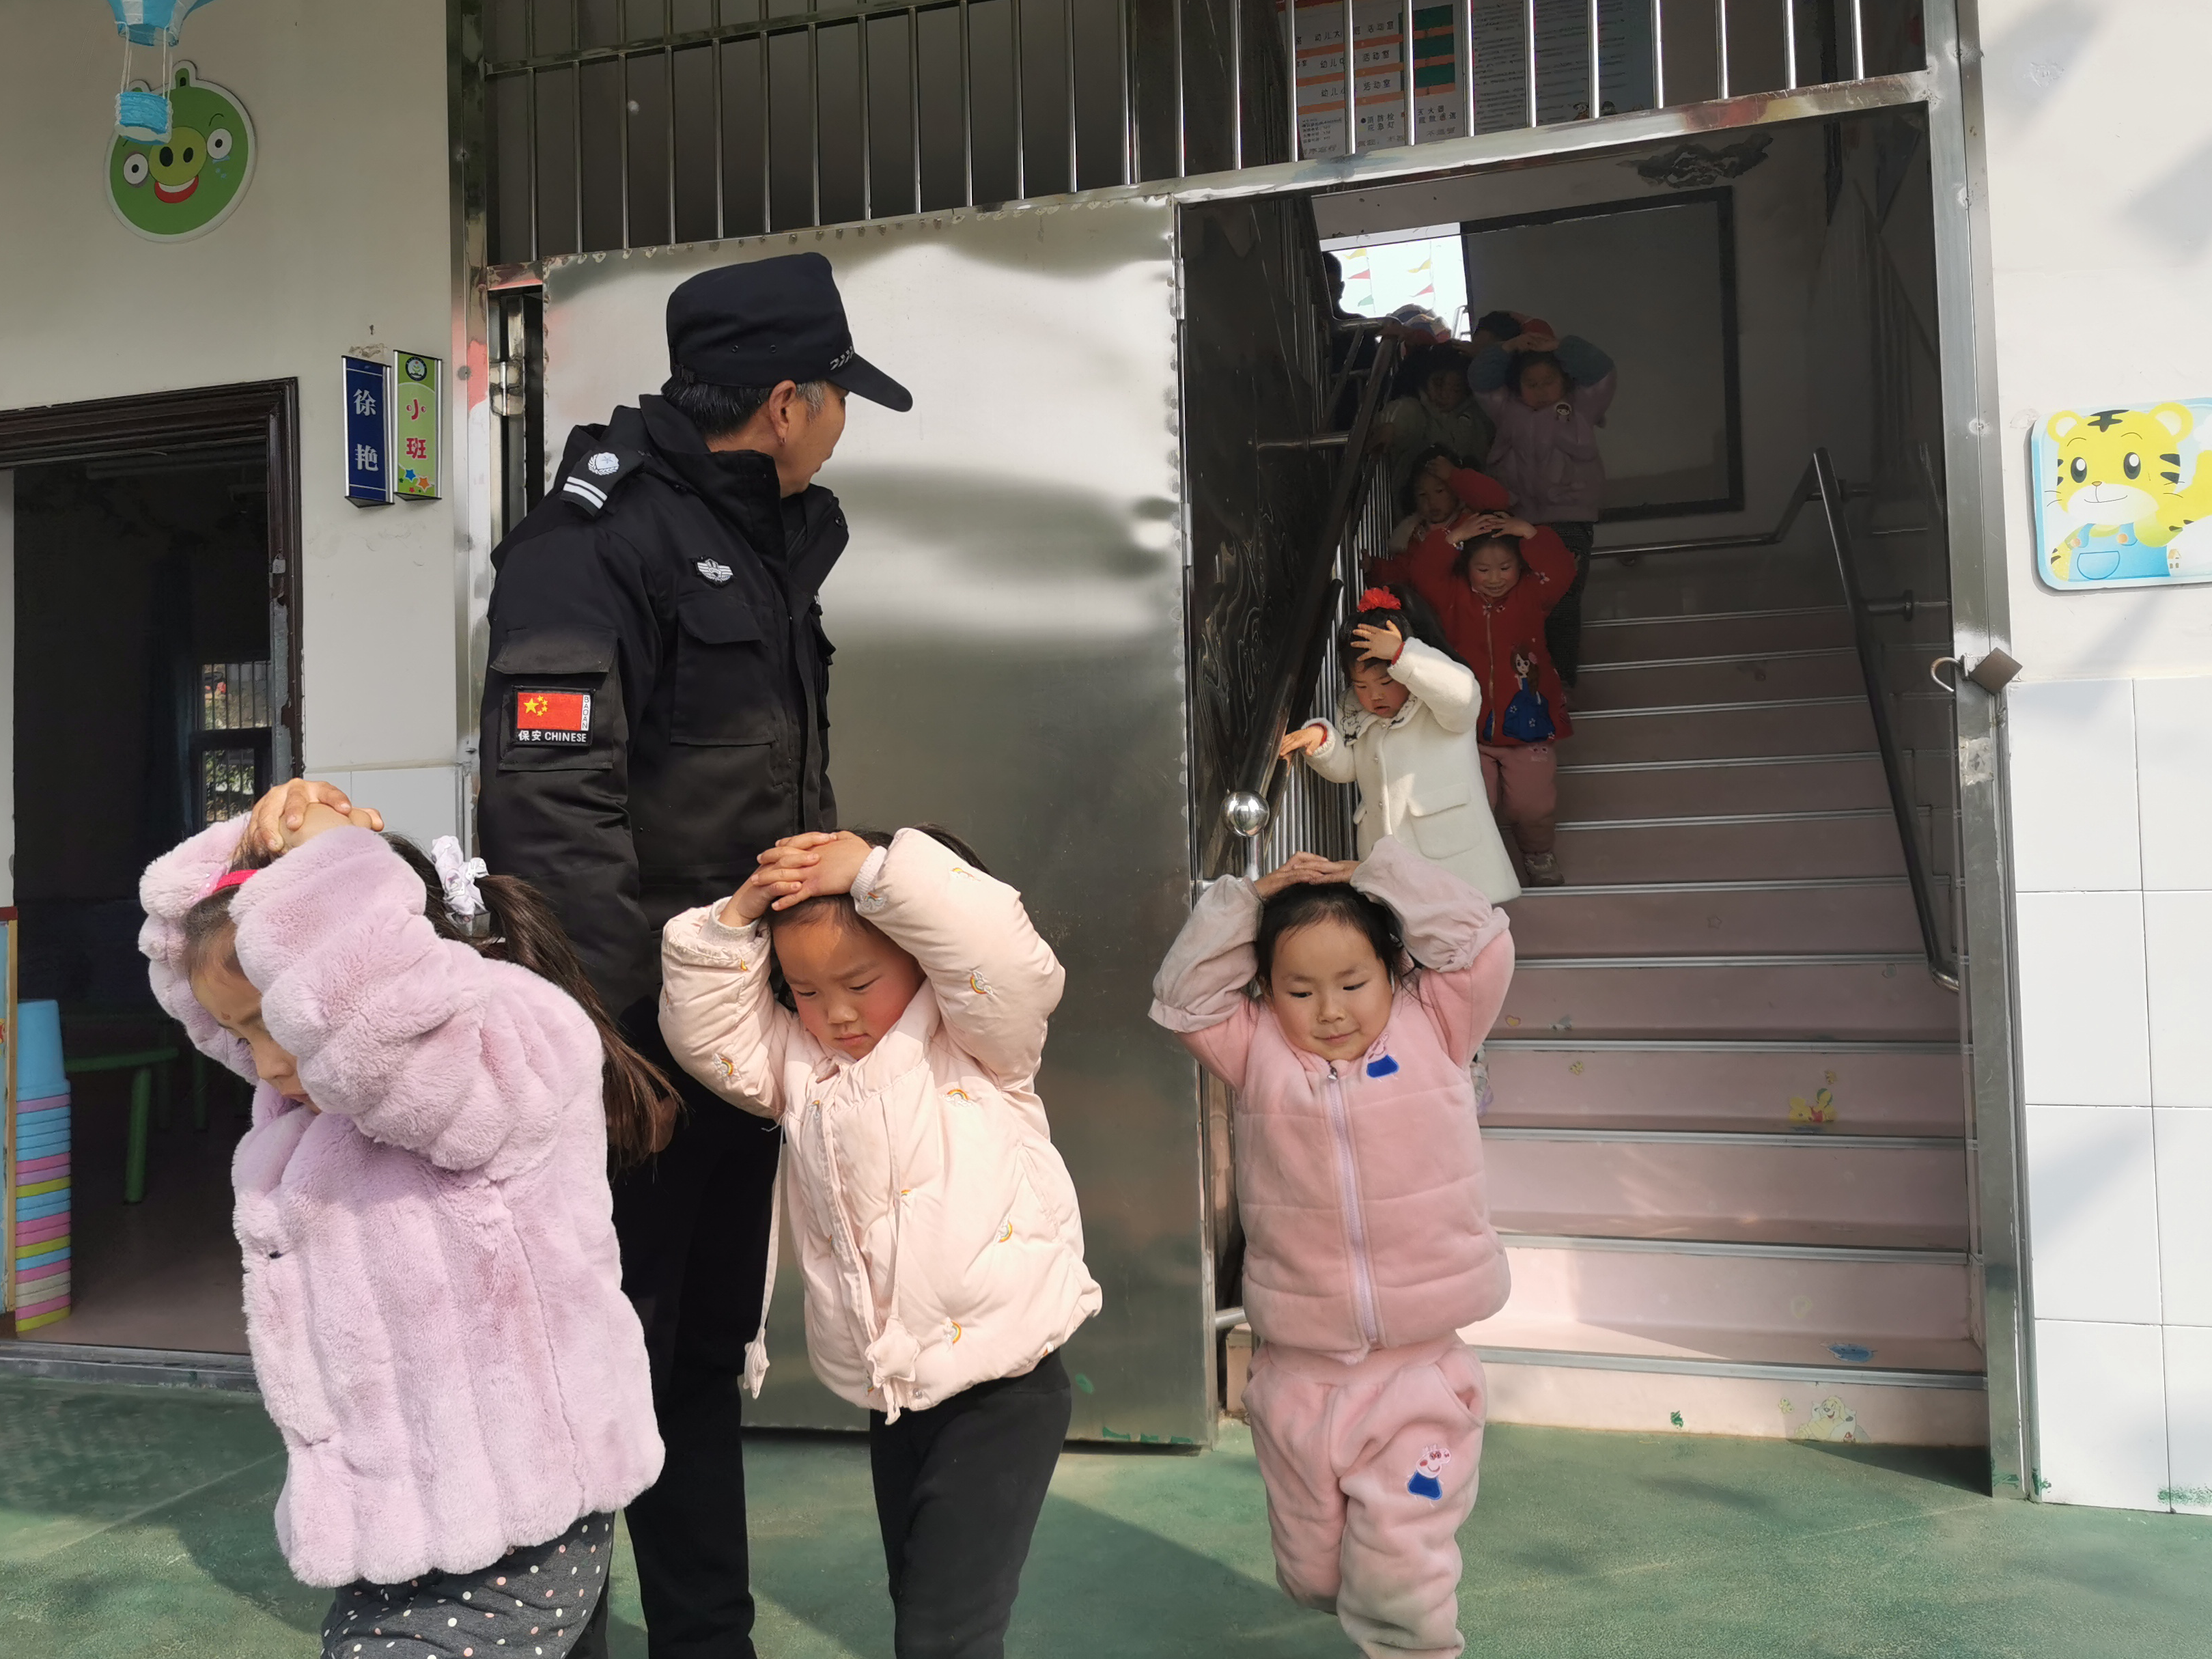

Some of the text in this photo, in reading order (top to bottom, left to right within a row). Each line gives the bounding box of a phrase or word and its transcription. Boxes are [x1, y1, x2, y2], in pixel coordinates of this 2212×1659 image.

[353, 388, 379, 472] 徐艳
[406, 399, 428, 460] 小班
[518, 729, 587, 742] 保安 CHINESE
